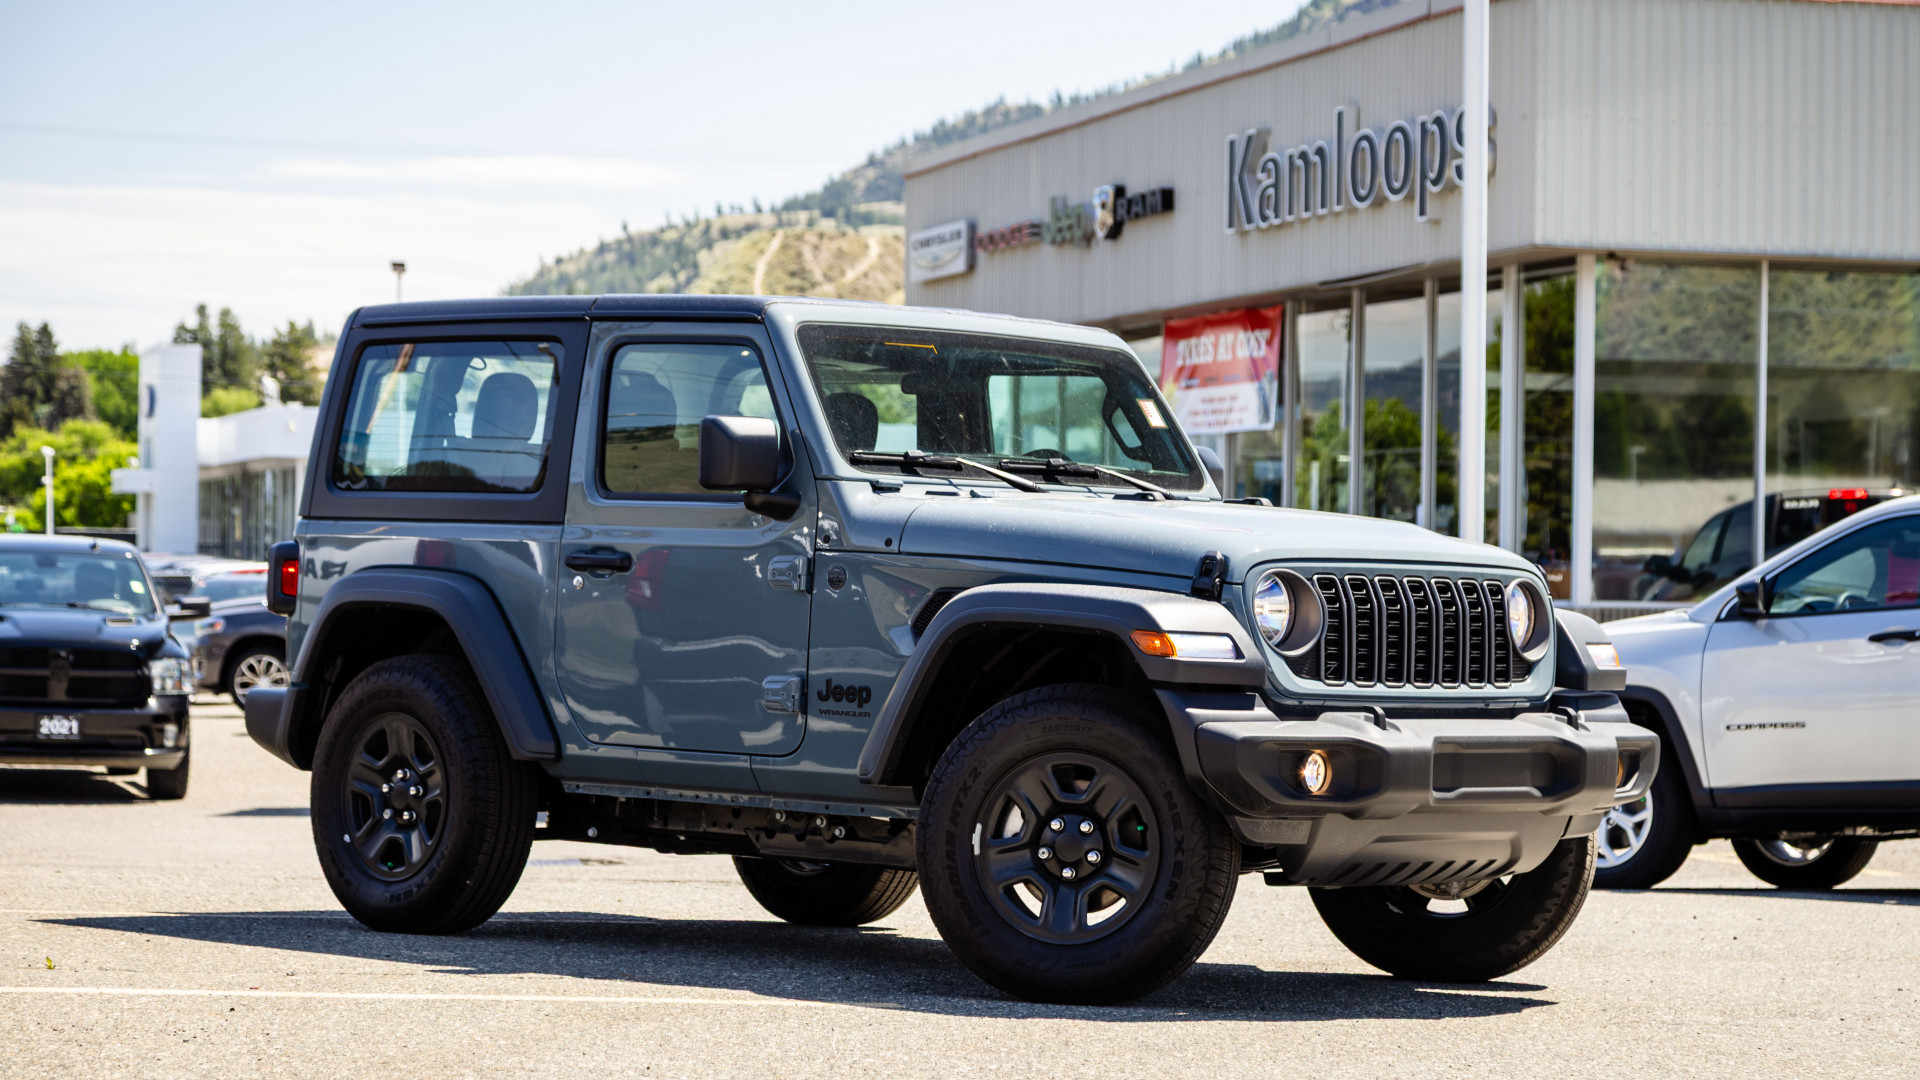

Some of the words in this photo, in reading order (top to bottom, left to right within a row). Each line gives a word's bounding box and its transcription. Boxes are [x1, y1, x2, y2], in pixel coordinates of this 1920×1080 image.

[1115, 190, 1164, 222] RAM
[911, 229, 962, 252] CHRYSLER
[975, 220, 1032, 252] DODGE
[817, 678, 872, 709] Jeep
[39, 718, 79, 735] 2021
[818, 708, 872, 718] WRANGLER
[1726, 721, 1806, 731] COMPASS
[1162, 790, 1185, 902] NEXEN
